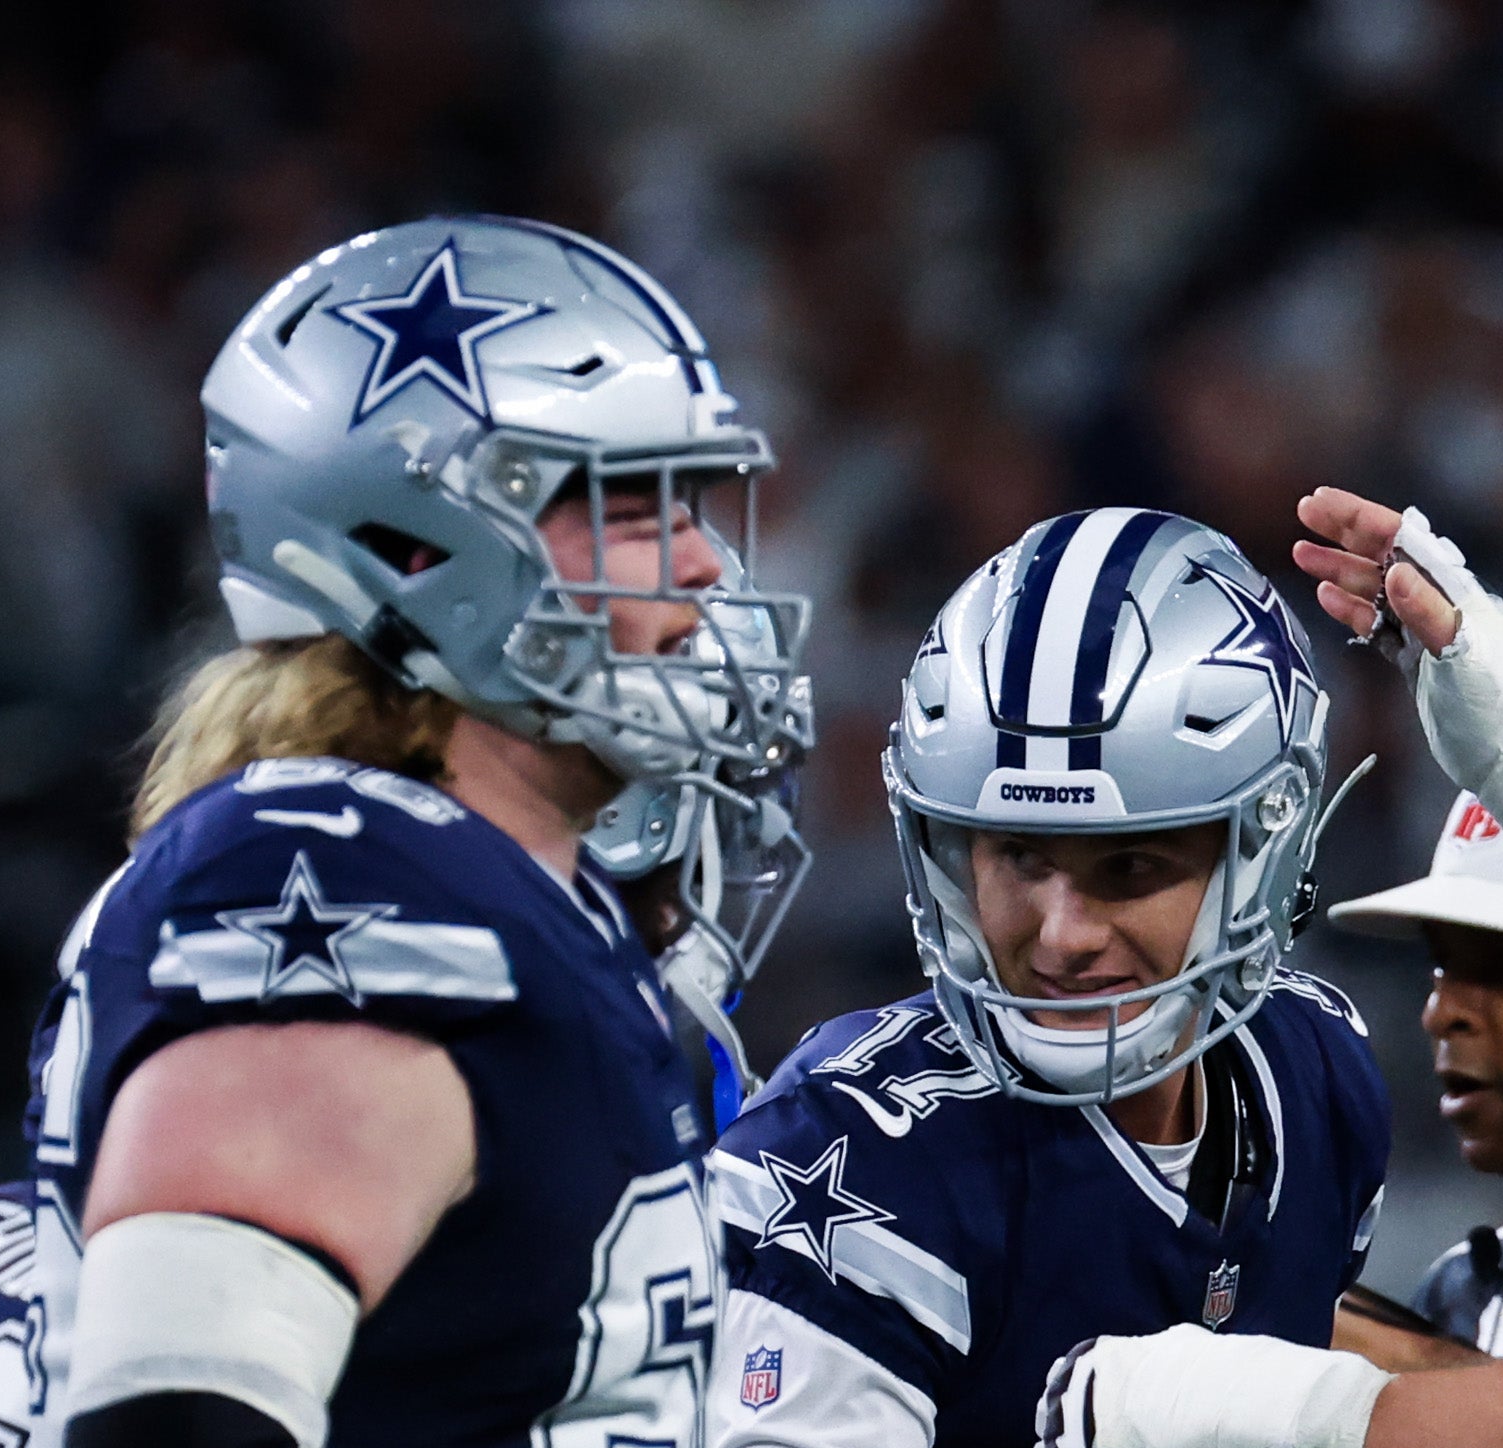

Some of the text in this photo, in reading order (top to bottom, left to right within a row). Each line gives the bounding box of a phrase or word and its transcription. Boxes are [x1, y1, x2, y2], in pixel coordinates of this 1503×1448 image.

[1000, 783, 1095, 804] COWBOYS
[809, 1006, 1023, 1120] 17
[743, 1372, 776, 1404] NFL
